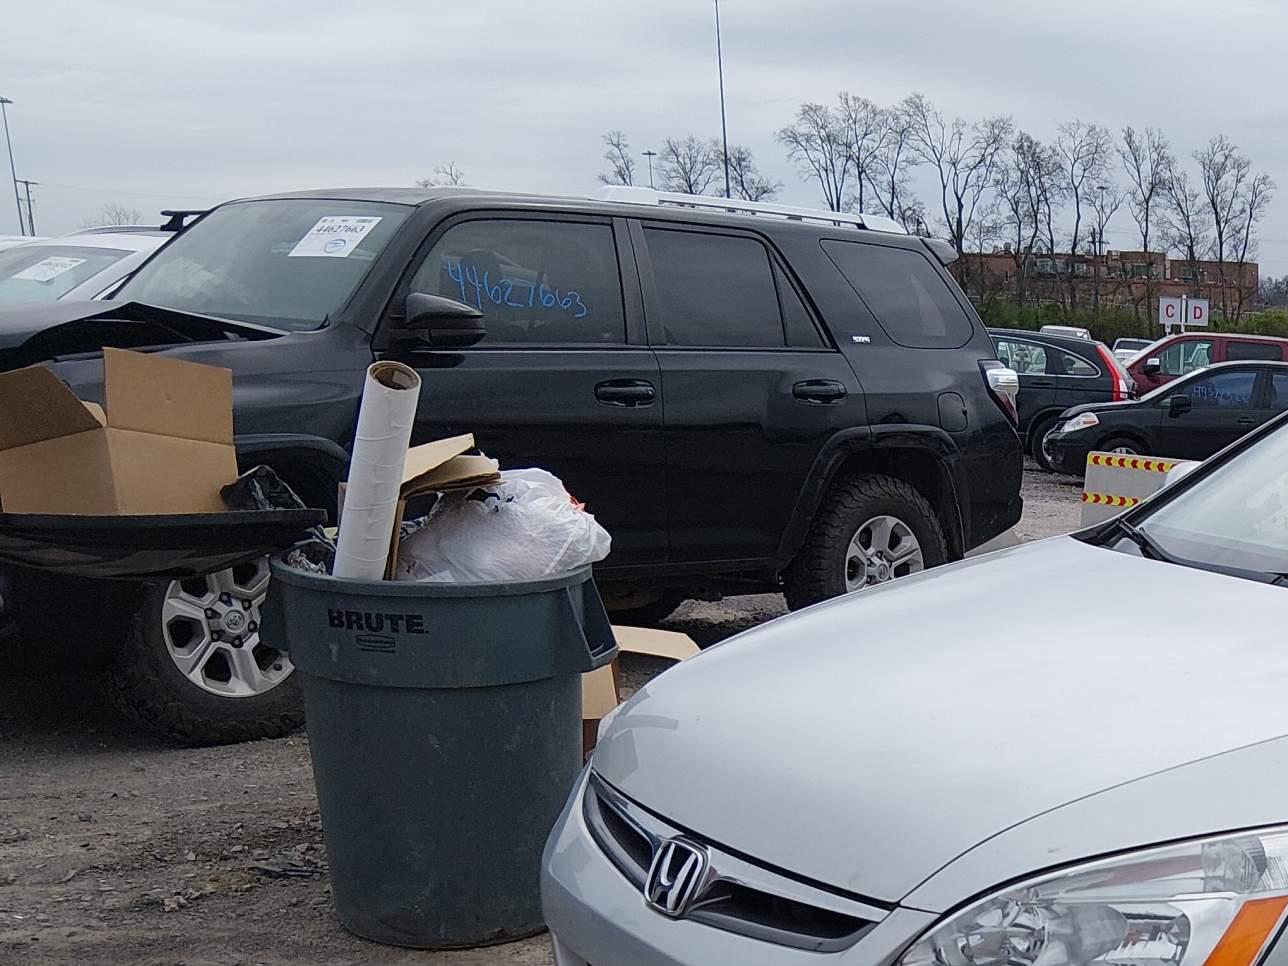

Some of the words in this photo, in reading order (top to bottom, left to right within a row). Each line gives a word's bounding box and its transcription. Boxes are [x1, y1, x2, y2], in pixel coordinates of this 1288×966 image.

[448, 262, 587, 318] 44627663
[1166, 304, 1175, 318] C
[1193, 305, 1203, 320] D
